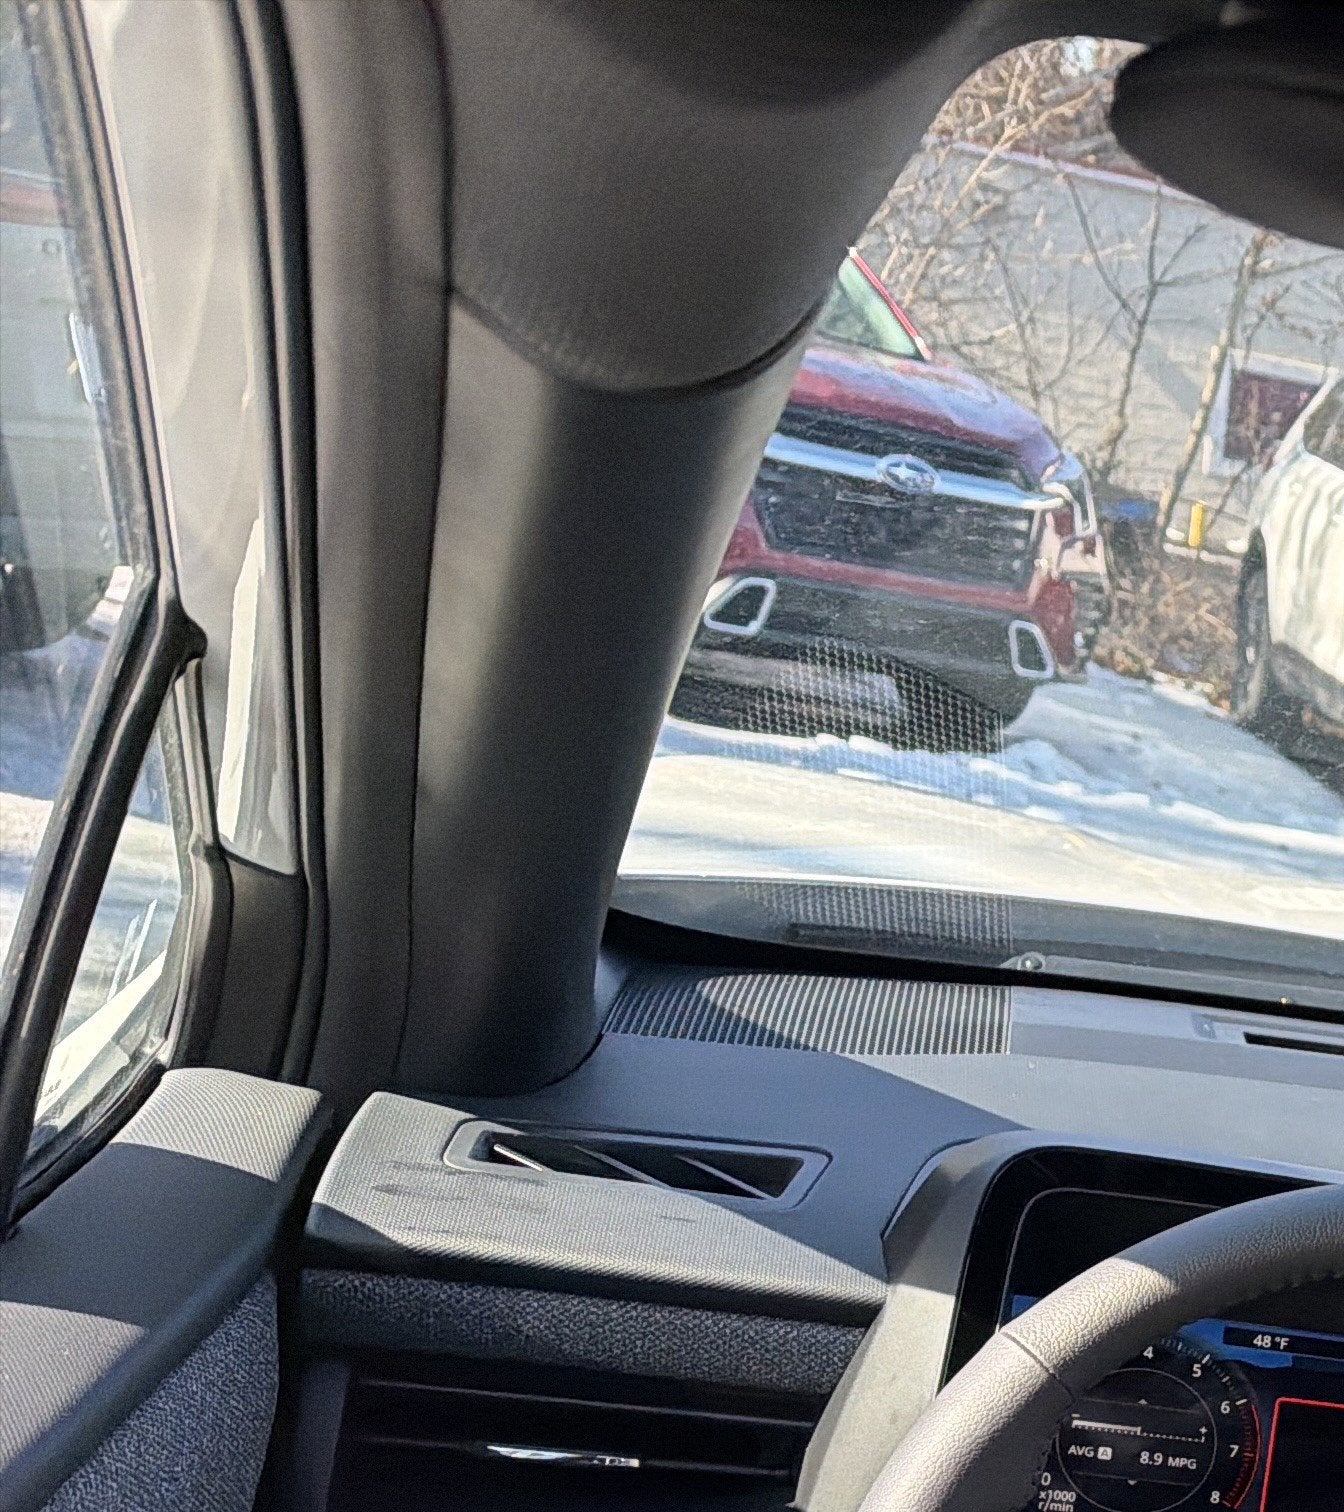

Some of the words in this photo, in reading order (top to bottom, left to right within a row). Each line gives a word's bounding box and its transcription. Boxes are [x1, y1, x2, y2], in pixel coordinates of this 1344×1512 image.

[1252, 1335, 1273, 1349] 48
[1143, 1346, 1154, 1360] 4
[1191, 1364, 1202, 1378] 5
[1220, 1401, 1231, 1414] 6
[1067, 1445, 1095, 1459] AVG
[1139, 1451, 1164, 1466] 8.9
[1167, 1456, 1197, 1470] MPG
[1229, 1444, 1240, 1458] 7
[1041, 1472, 1051, 1486] 0
[1038, 1489, 1077, 1502] x1000
[1210, 1490, 1220, 1504] 8
